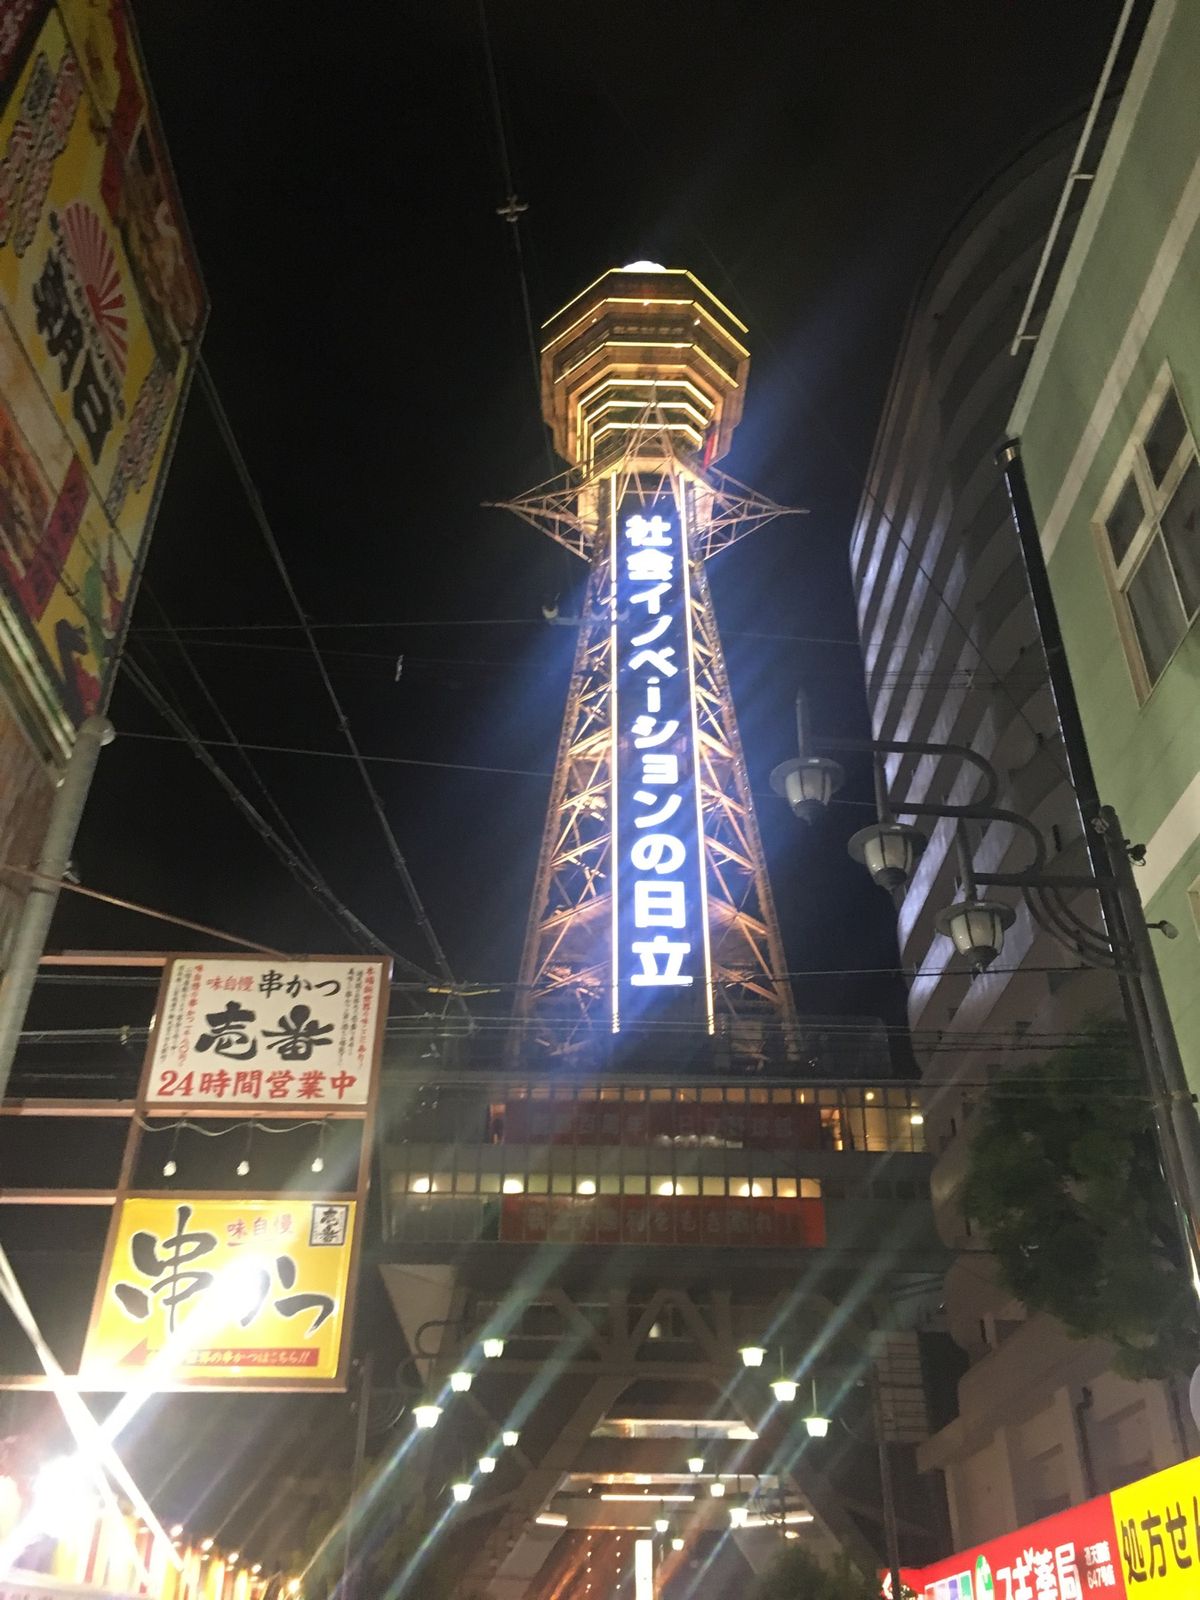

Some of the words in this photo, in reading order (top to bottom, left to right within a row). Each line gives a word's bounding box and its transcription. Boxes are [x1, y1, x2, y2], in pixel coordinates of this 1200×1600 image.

[625, 514, 695, 988] 社会イノベーションの日立
[206, 975, 254, 992] 味自慢
[259, 969, 341, 999] 串かつ
[194, 1000, 335, 1061] 壱番
[157, 1069, 357, 1100] 24時間営業中
[227, 1214, 294, 1239] 味自慢
[996, 1542, 1082, 1600] スギ薬局
